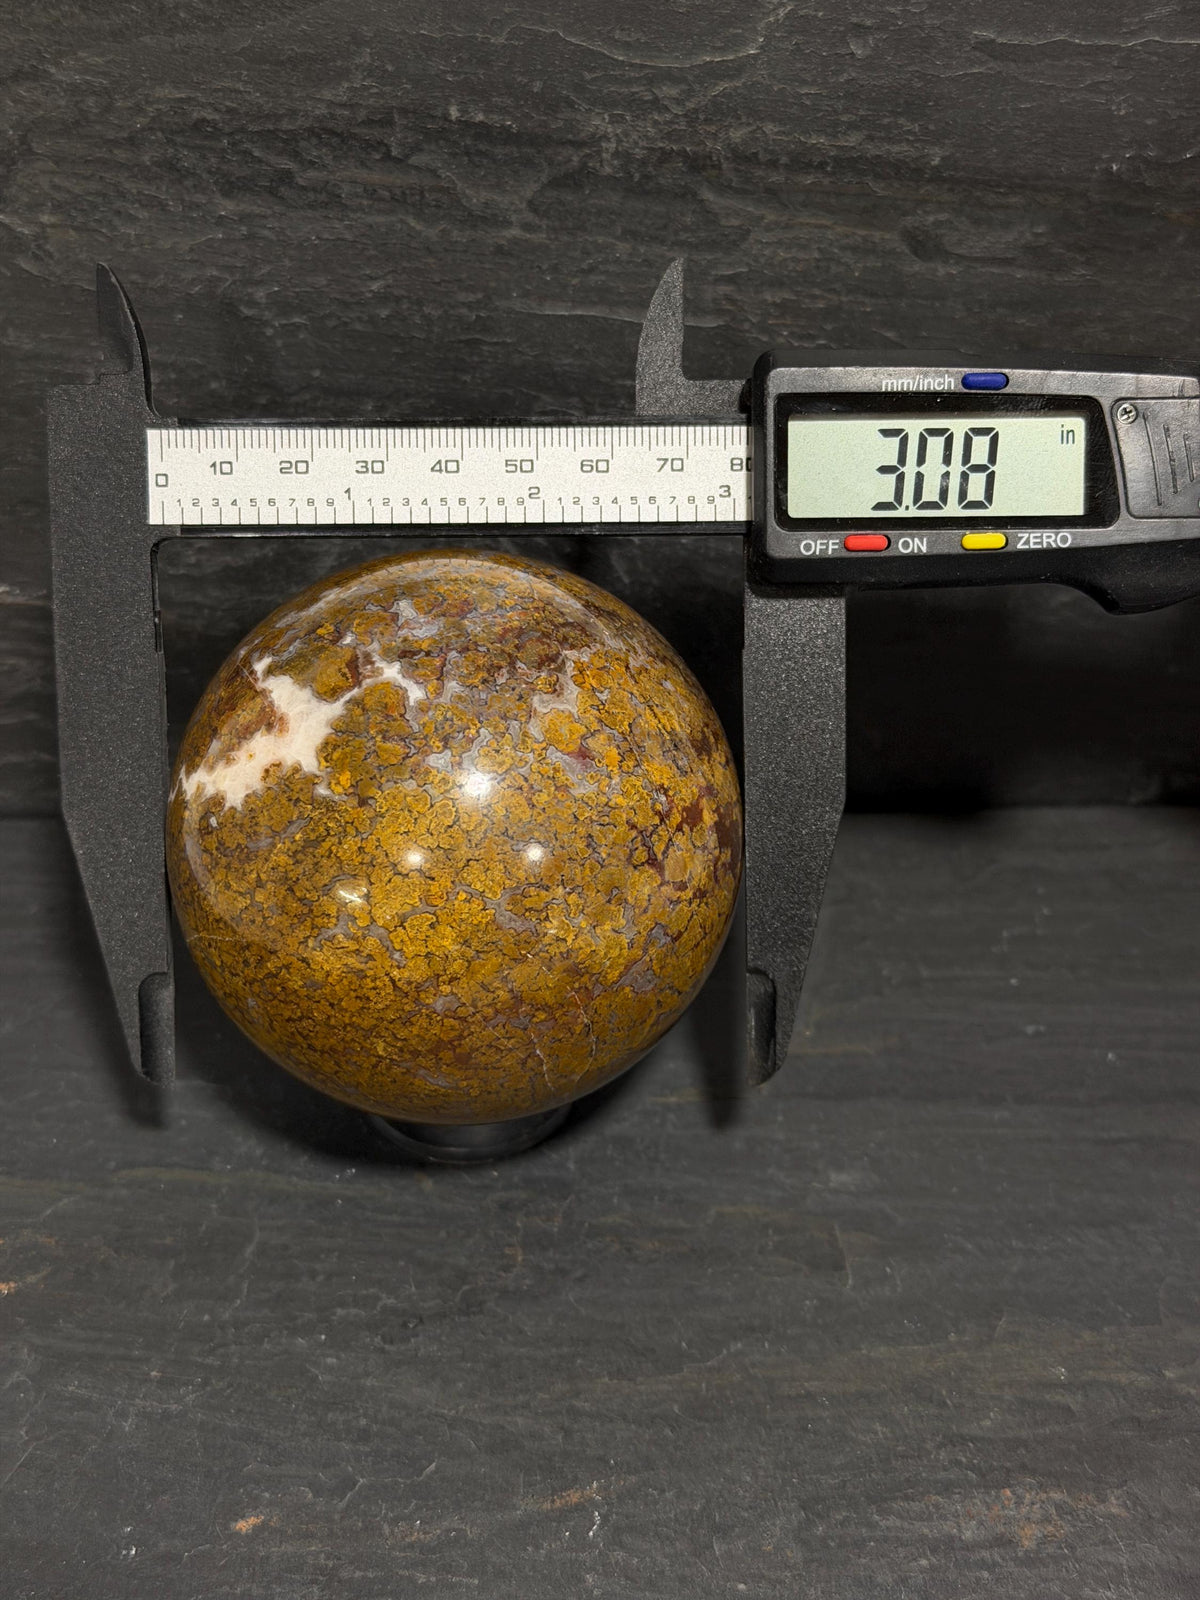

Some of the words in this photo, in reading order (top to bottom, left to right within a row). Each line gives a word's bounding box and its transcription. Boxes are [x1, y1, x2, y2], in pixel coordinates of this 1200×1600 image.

[881, 375, 955, 393] mm/inch
[1060, 424, 1076, 446] in
[210, 460, 233, 475] 10
[279, 460, 309, 475] 20
[356, 460, 384, 475] 30
[430, 459, 460, 473] 40
[505, 458, 534, 473] 50
[581, 458, 609, 473] 60
[657, 458, 684, 473] 70
[870, 426, 1000, 512] 3.08
[156, 473, 168, 488] 0
[177, 498, 181, 506] 1
[192, 498, 200, 506] 2
[212, 498, 219, 506] 3
[231, 498, 238, 506] 4
[250, 498, 257, 506] 5
[268, 498, 276, 506] 6
[289, 498, 296, 506] 7
[307, 498, 314, 506] 8
[326, 498, 334, 506] 9
[344, 488, 352, 500] 1
[367, 498, 372, 506] 1
[382, 498, 390, 506] 2
[402, 498, 409, 506] 3
[421, 498, 428, 506] 4
[440, 498, 447, 506] 5
[459, 497, 466, 505] 6
[479, 497, 486, 505] 7
[497, 497, 504, 505] 8
[517, 497, 524, 505] 9
[528, 486, 540, 499] 2
[558, 497, 562, 505] 1
[573, 497, 581, 505] 2
[592, 497, 600, 505] 3
[612, 497, 619, 505] 4
[630, 497, 637, 505] 5
[648, 497, 656, 505] 6
[669, 497, 676, 505] 7
[687, 497, 695, 505] 8
[707, 497, 714, 505] 9
[719, 485, 731, 498] 3
[799, 540, 840, 556] OFF
[898, 538, 928, 554] ON
[1016, 533, 1072, 550] ZERO
